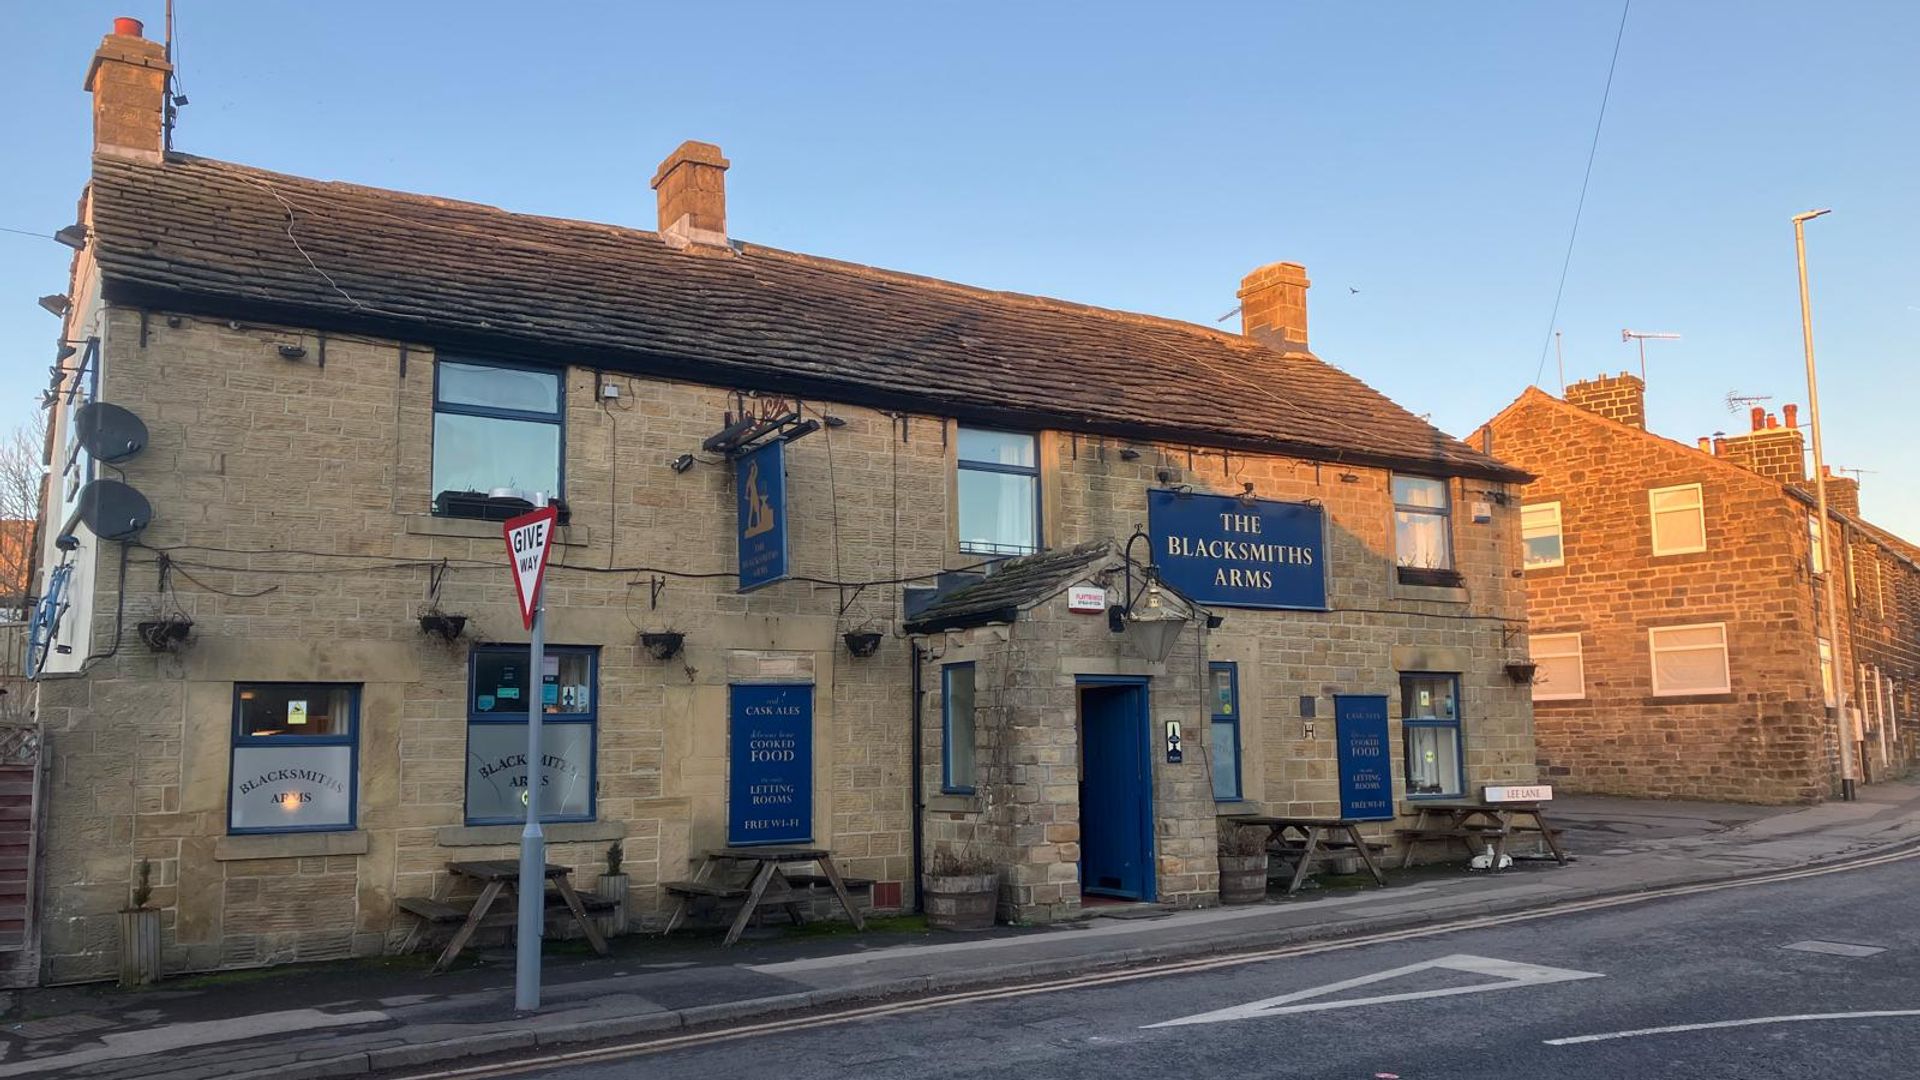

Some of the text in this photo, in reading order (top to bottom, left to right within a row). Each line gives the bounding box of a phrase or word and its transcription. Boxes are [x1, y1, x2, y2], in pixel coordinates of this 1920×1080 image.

[1220, 513, 1262, 534] THE
[513, 524, 543, 554] GIVE
[1167, 536, 1313, 566] BLACKSMITHS
[520, 555, 539, 573] WAY
[1214, 567, 1273, 590] ARMS
[746, 706, 800, 715] CASK ALES
[750, 740, 795, 749] COOKED
[751, 750, 795, 762] FOOD
[1352, 747, 1380, 757] FOOD
[478, 754, 578, 779] BLACKITHS
[239, 769, 344, 795] BLACKSMITHS
[509, 775, 549, 787] ARS
[750, 784, 794, 794] LETTING
[1507, 789, 1540, 799] LEE LANE
[752, 795, 792, 805] ROOMS
[744, 820, 769, 829] FREE
